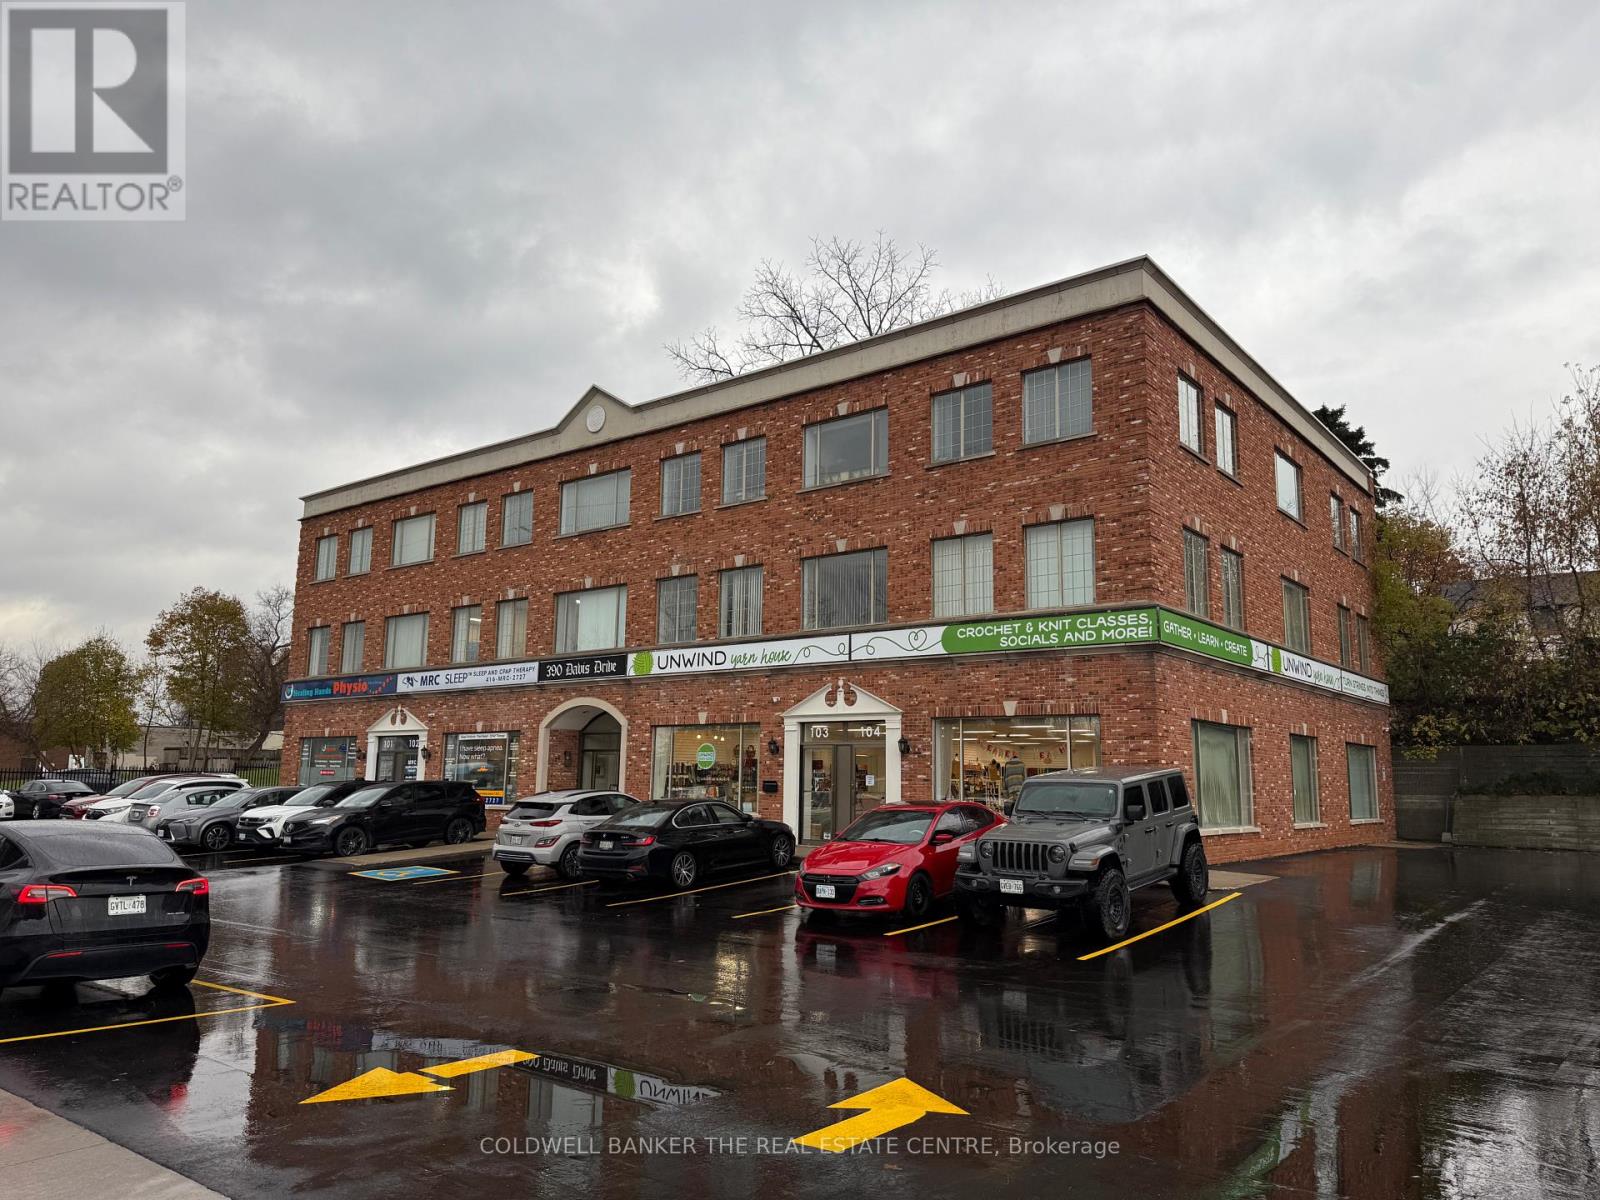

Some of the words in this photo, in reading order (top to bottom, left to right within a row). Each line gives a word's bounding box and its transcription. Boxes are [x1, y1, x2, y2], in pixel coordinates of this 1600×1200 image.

[957, 623, 1021, 638] CROCHET
[1025, 622, 1034, 633] &
[1038, 619, 1072, 632] KNIT
[1077, 613, 1152, 628] CLASSES,
[1000, 633, 1059, 647] SOCIALS
[1064, 630, 1096, 643] AND
[1102, 626, 1153, 640] MORE!
[1163, 620, 1192, 640] GATHER
[1198, 632, 1220, 648] LEARN
[1224, 640, 1248, 656] CREATE
[657, 650, 727, 670] UNWIND
[730, 651, 758, 669] yarn
[760, 648, 792, 665] house
[1283, 655, 1312, 678] UNWIND
[546, 663, 563, 677] 390
[565, 661, 590, 676] Davis
[594, 660, 617, 673] Drive
[333, 679, 369, 696] Physio
[420, 674, 440, 686] MRC
[445, 672, 468, 684] SLEEP
[811, 727, 829, 738] 103
[861, 726, 881, 737] 104
[383, 740, 393, 748] 101
[408, 739, 420, 748] 102
